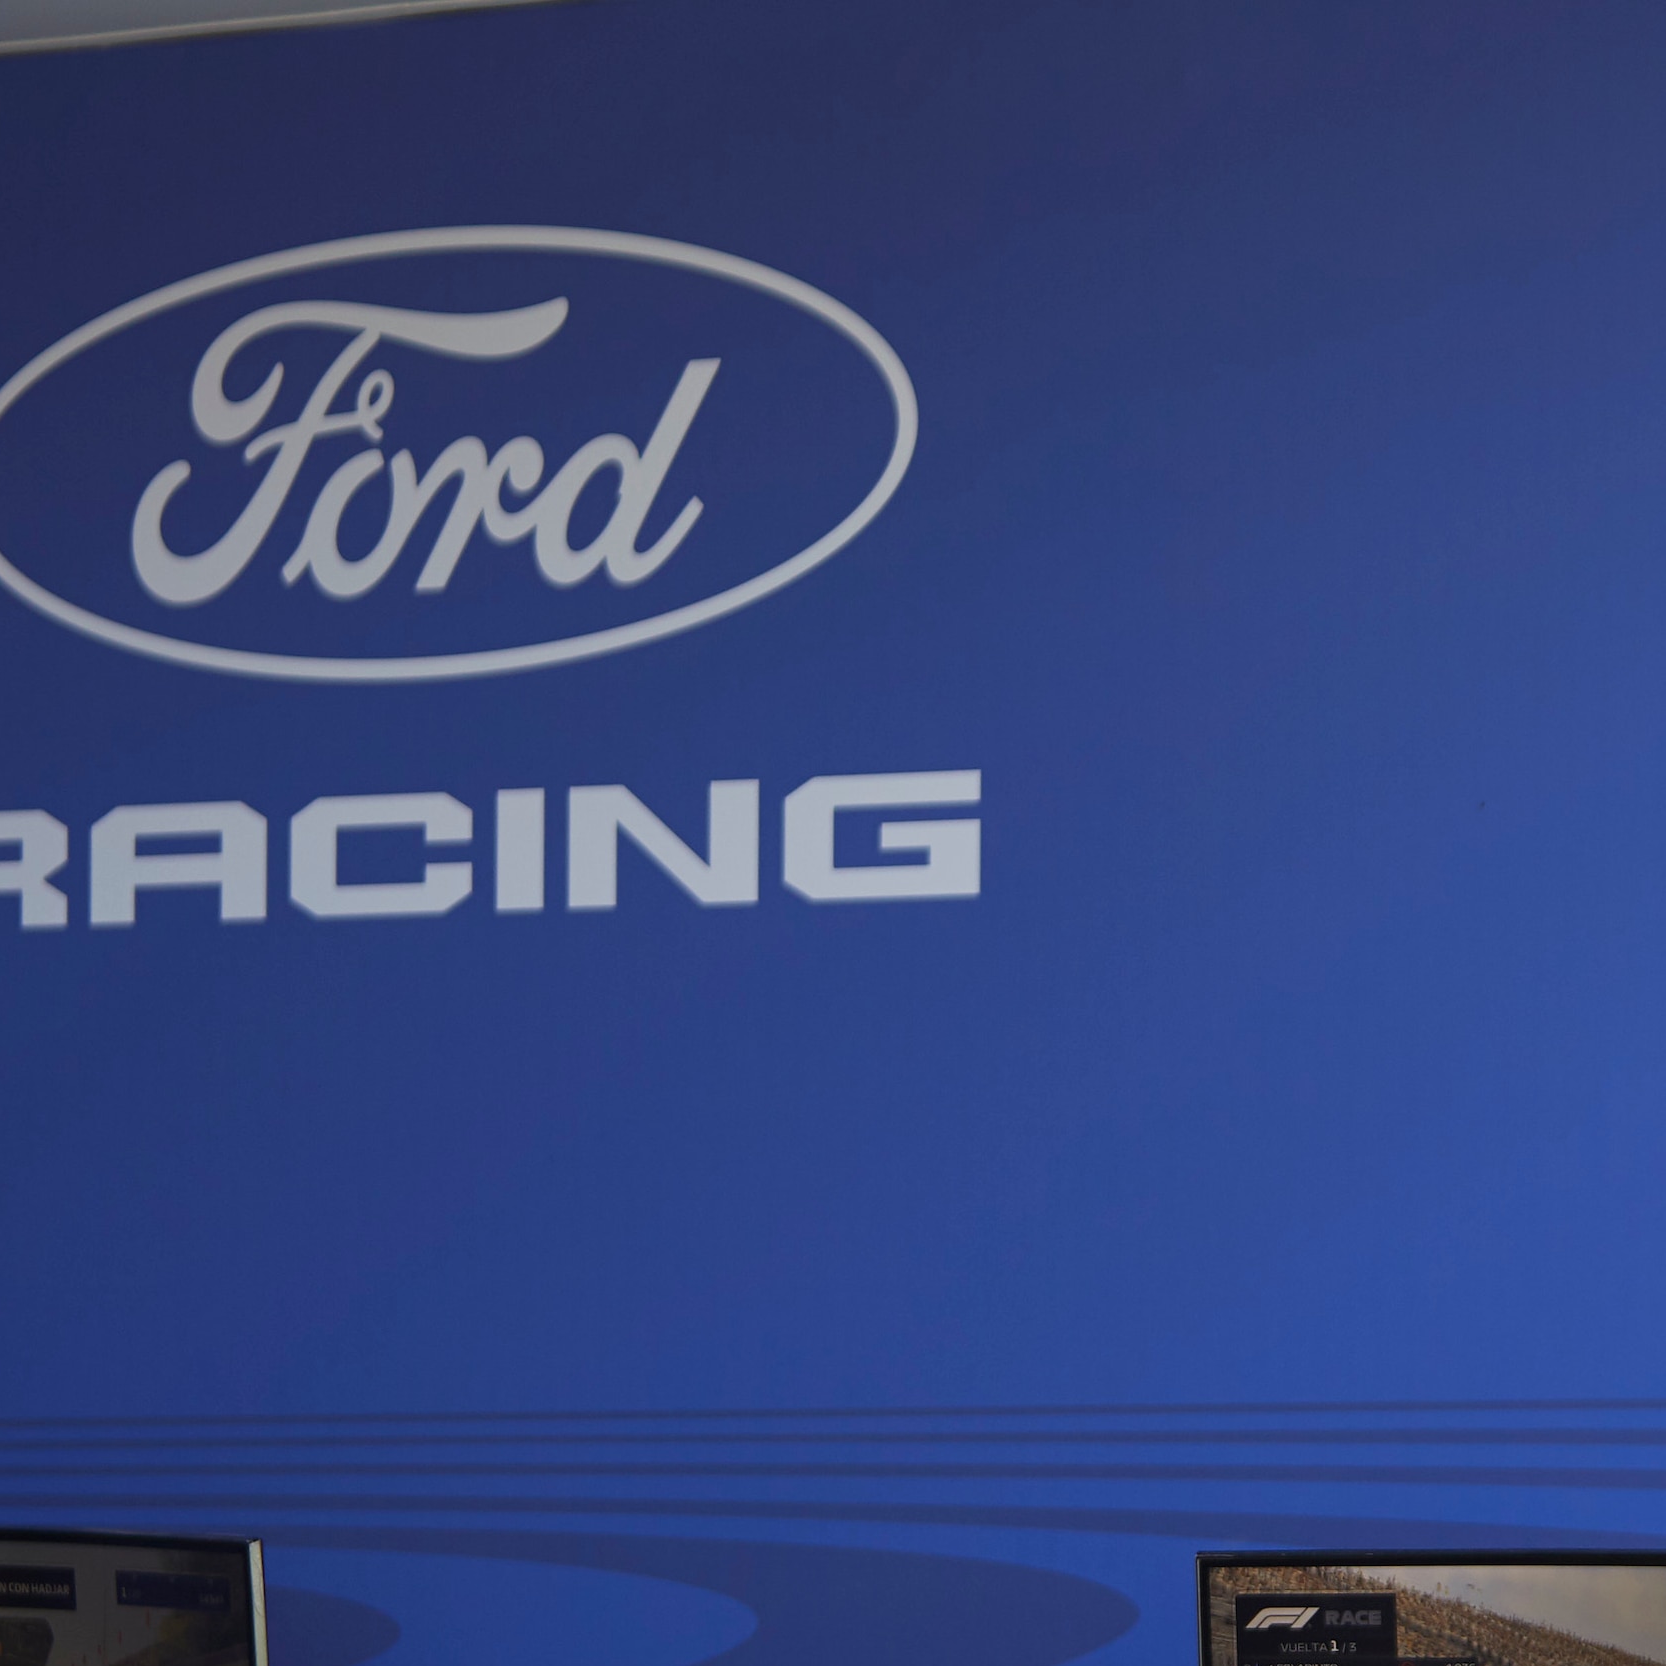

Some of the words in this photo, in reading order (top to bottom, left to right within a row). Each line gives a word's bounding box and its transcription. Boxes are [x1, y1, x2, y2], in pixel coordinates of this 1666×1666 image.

[131, 295, 722, 605] Ford
[8, 1583, 30, 1593] CON
[32, 1583, 70, 1596] HADJAR
[1325, 1609, 1382, 1626] RACE
[1280, 1642, 1328, 1653] VUELTA
[1330, 1639, 1339, 1652] 1
[1349, 1642, 1357, 1652] 3
